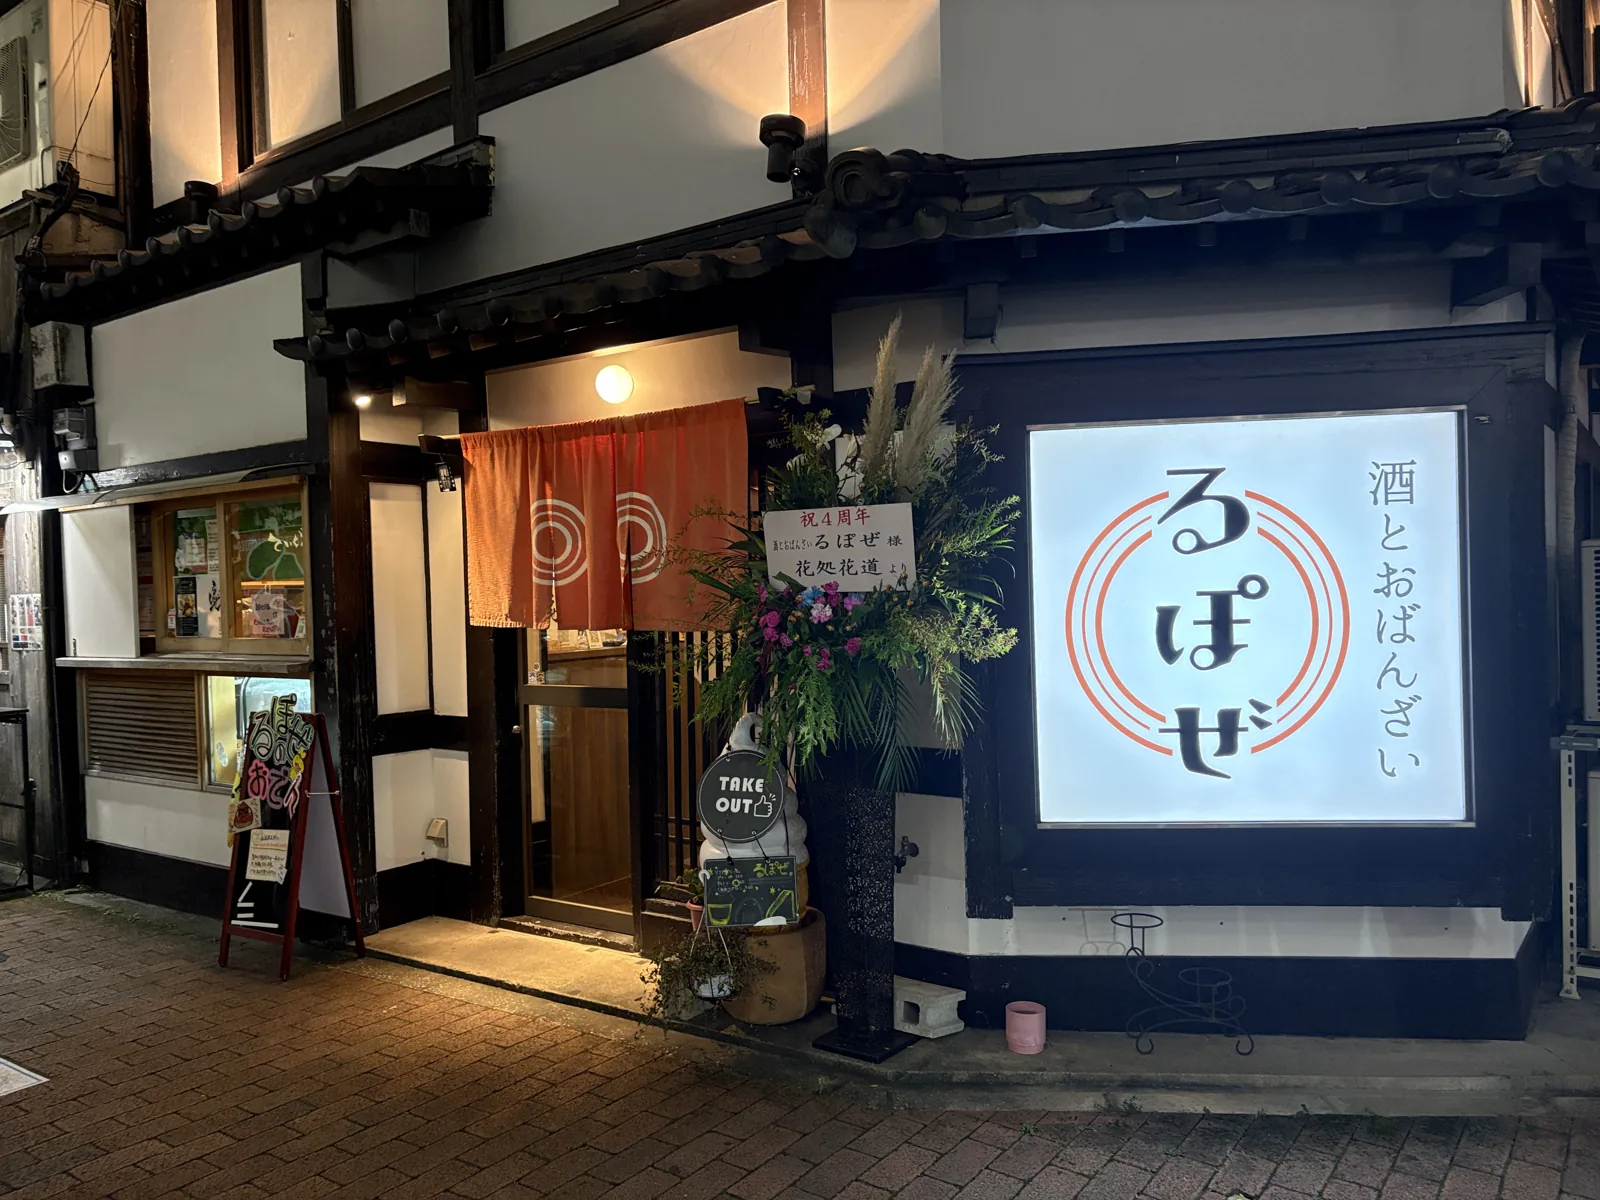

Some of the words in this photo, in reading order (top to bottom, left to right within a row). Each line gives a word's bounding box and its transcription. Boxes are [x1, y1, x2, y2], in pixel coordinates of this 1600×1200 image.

[800, 507, 871, 528] 祝4周年
[795, 557, 883, 578] 花処花道
[1155, 466, 1273, 780] るぽぜ
[1368, 458, 1422, 778] 酒とおばんざい
[247, 759, 302, 821] おでん
[719, 776, 765, 793] TAKE
[715, 797, 753, 814] OUT
